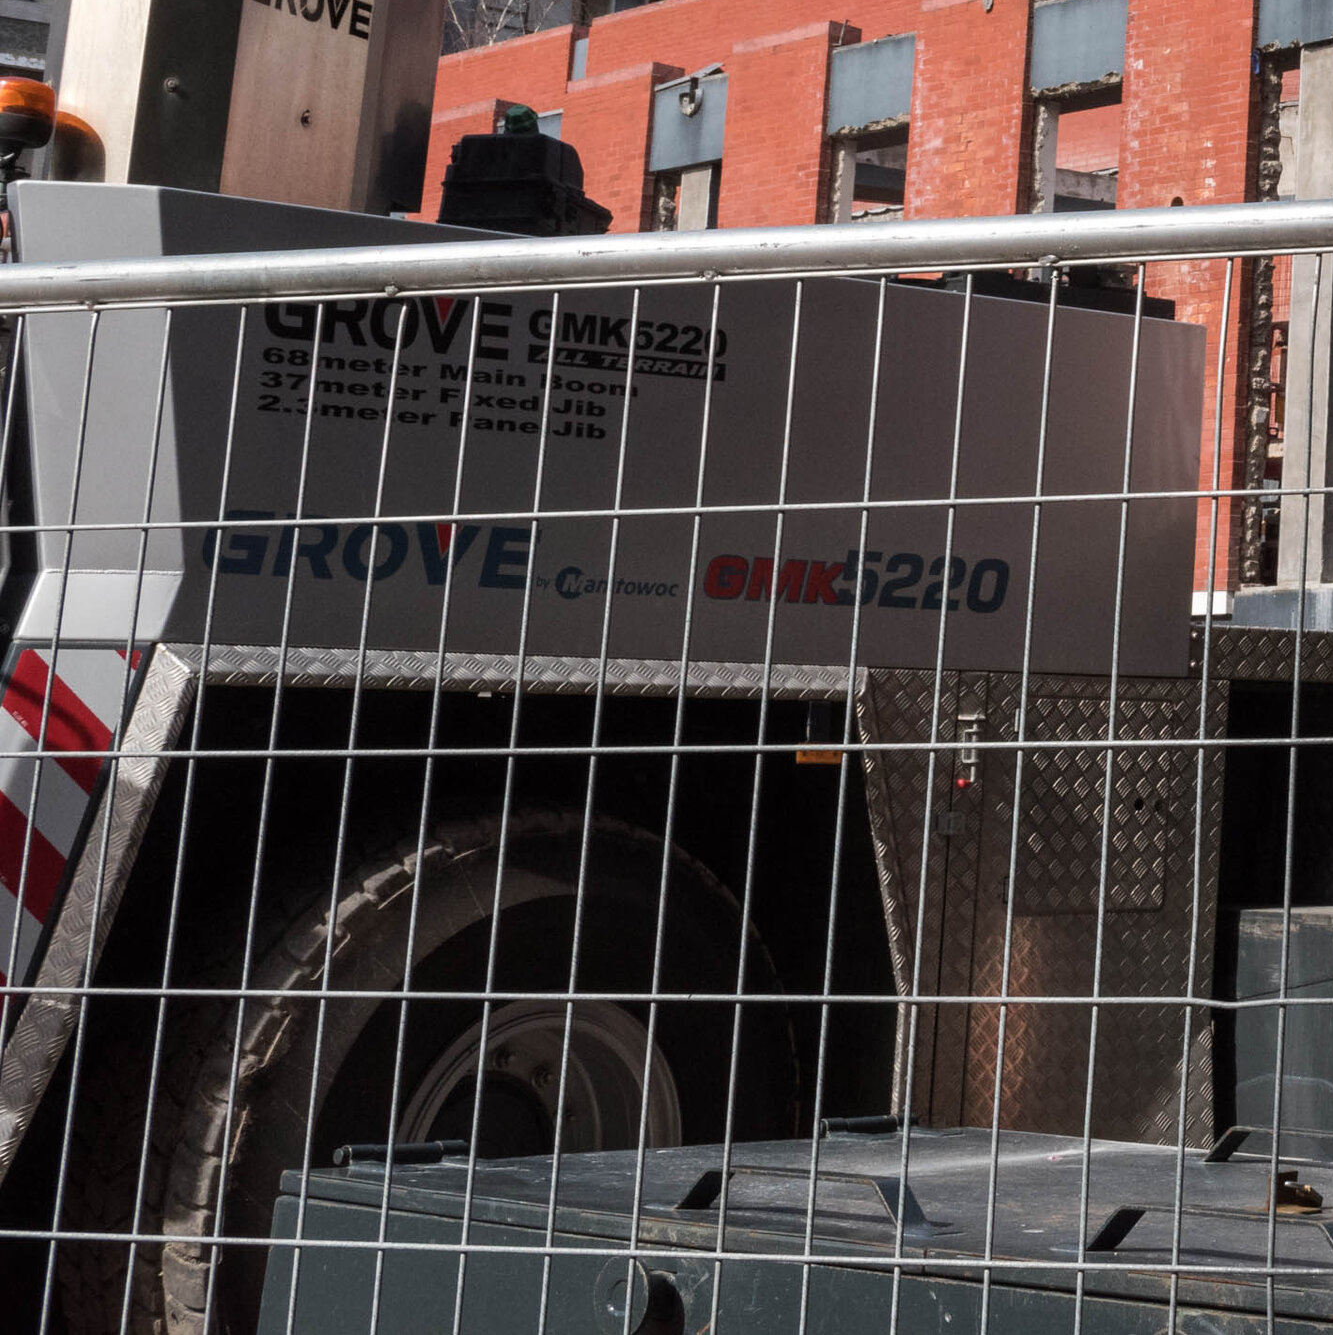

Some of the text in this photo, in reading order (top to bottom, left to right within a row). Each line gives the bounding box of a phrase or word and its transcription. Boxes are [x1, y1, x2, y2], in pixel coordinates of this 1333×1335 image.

[264, 294, 728, 361] GROVE GMK5220
[535, 350, 590, 366] ALL
[440, 363, 526, 388] Main
[541, 372, 638, 397] Boom
[440, 387, 540, 413] Fxed
[552, 398, 606, 417] Jib
[552, 420, 606, 440] Jib
[202, 509, 542, 589] GROVE
[555, 566, 679, 599] Mantowoc
[703, 550, 1010, 614] GMK5220
